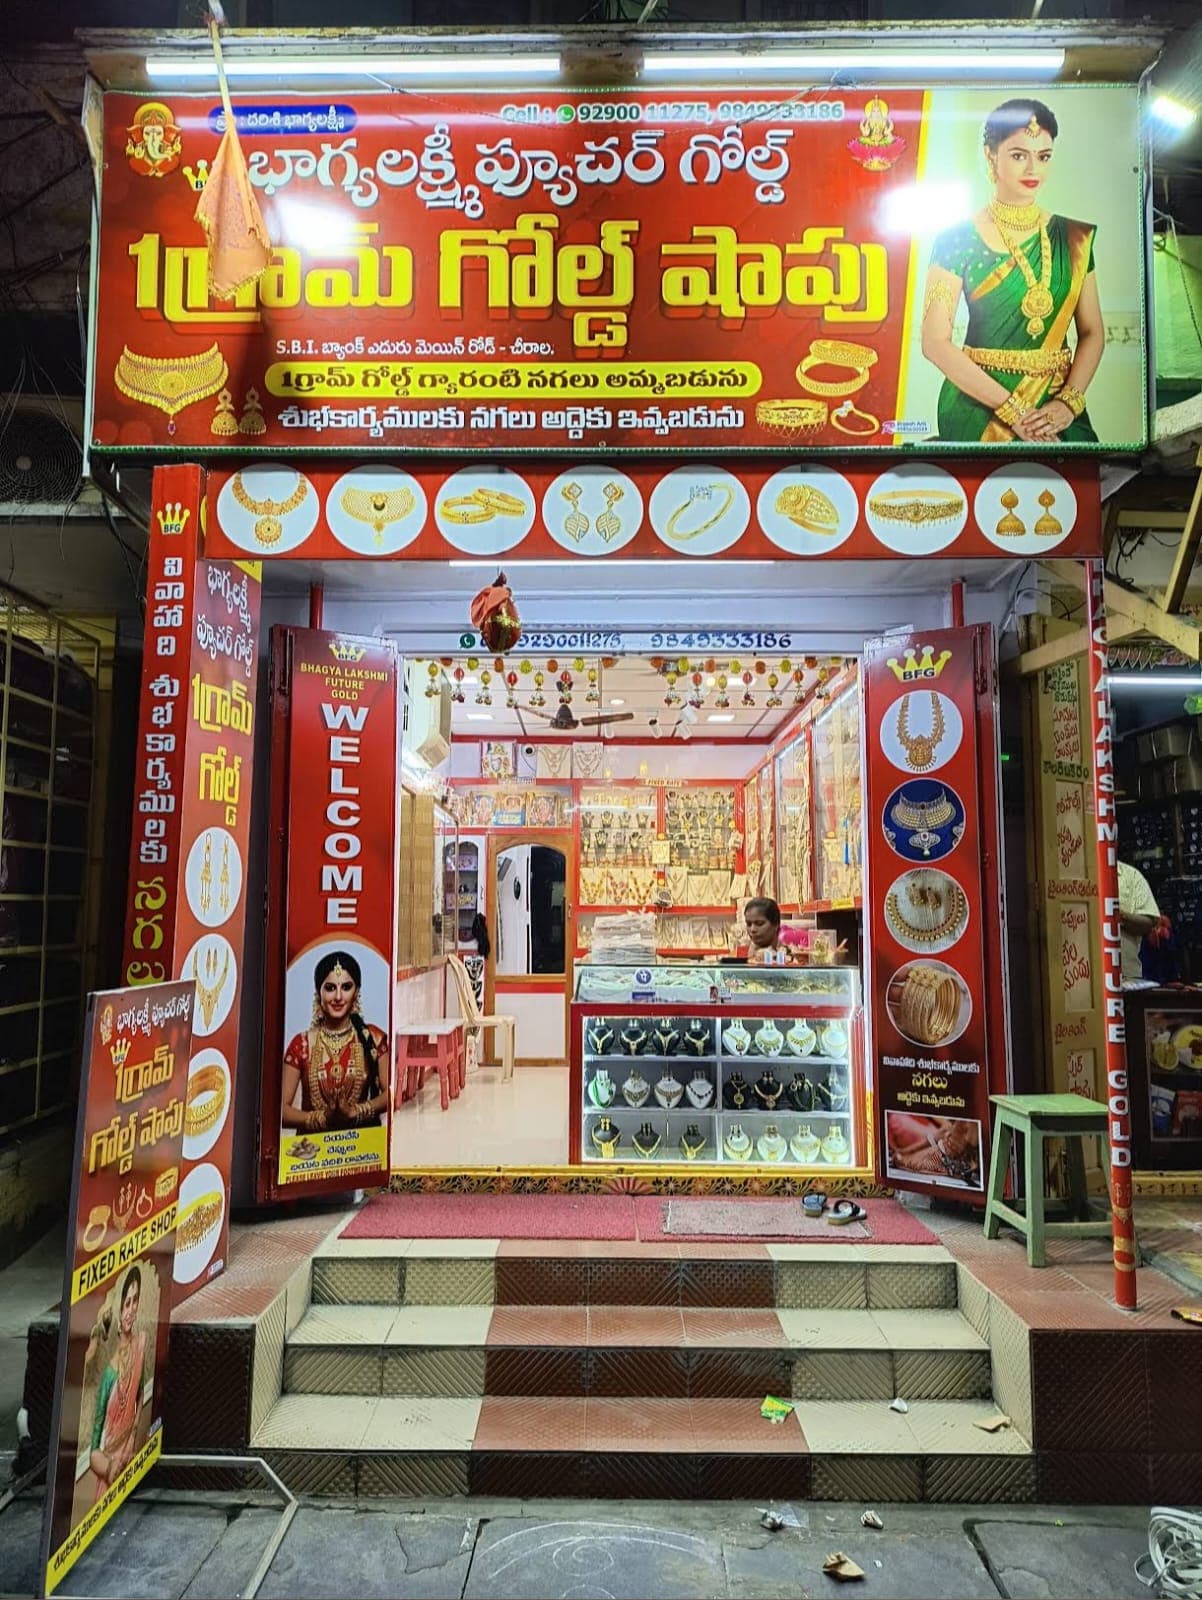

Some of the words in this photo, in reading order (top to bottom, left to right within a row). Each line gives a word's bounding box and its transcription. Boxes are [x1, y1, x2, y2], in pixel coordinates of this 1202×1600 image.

[502, 105, 538, 121] Cell
[578, 104, 640, 121] 92900
[646, 103, 713, 123] 11275,
[249, 122, 484, 219] భాగ్యలక్ష్మీ
[679, 127, 794, 204] గోల్డ్
[439, 213, 640, 348] గోల్డ్
[661, 226, 889, 323] షాపు
[276, 339, 319, 355] S.B.I.
[321, 335, 365, 361] బ్యాంక్
[367, 341, 412, 355] ఎదురు
[468, 336, 496, 355] రోడ్
[509, 337, 555, 355] చీరాల.
[281, 366, 355, 393] 1గ్రామ్
[361, 365, 414, 397] గోల్డ్
[527, 369, 599, 389] నగలు
[605, 368, 748, 395] అమ్మబడును
[278, 405, 465, 438] శుభకార్యములకు
[470, 405, 536, 429] నగలు
[617, 404, 745, 435] ఇవ్వబడును
[163, 523, 181, 533] BFG
[300, 662, 342, 677] BHAGYA
[345, 667, 388, 683] LAKSHMI
[325, 677, 365, 691] FUTURE
[331, 689, 358, 701] GOLD
[903, 667, 935, 681] BFG
[191, 673, 254, 737] 1గ్రామ్
[199, 746, 243, 827] గోల్డ్
[321, 703, 370, 926] WELCOME
[1095, 700, 1119, 868] LAKSHMI
[126, 876, 167, 987] నగలు
[1103, 897, 1125, 1044] FUTURE
[115, 1044, 175, 1104] 1గ్రామ్
[912, 1072, 948, 1089] నగలు
[88, 1112, 138, 1176] గోల్డ్
[140, 1098, 184, 1147] షాపు
[1107, 1069, 1131, 1167] GOLD
[78, 1251, 115, 1296] FIXED
[118, 1227, 148, 1265] RATE
[150, 1207, 177, 1242] SHOP
